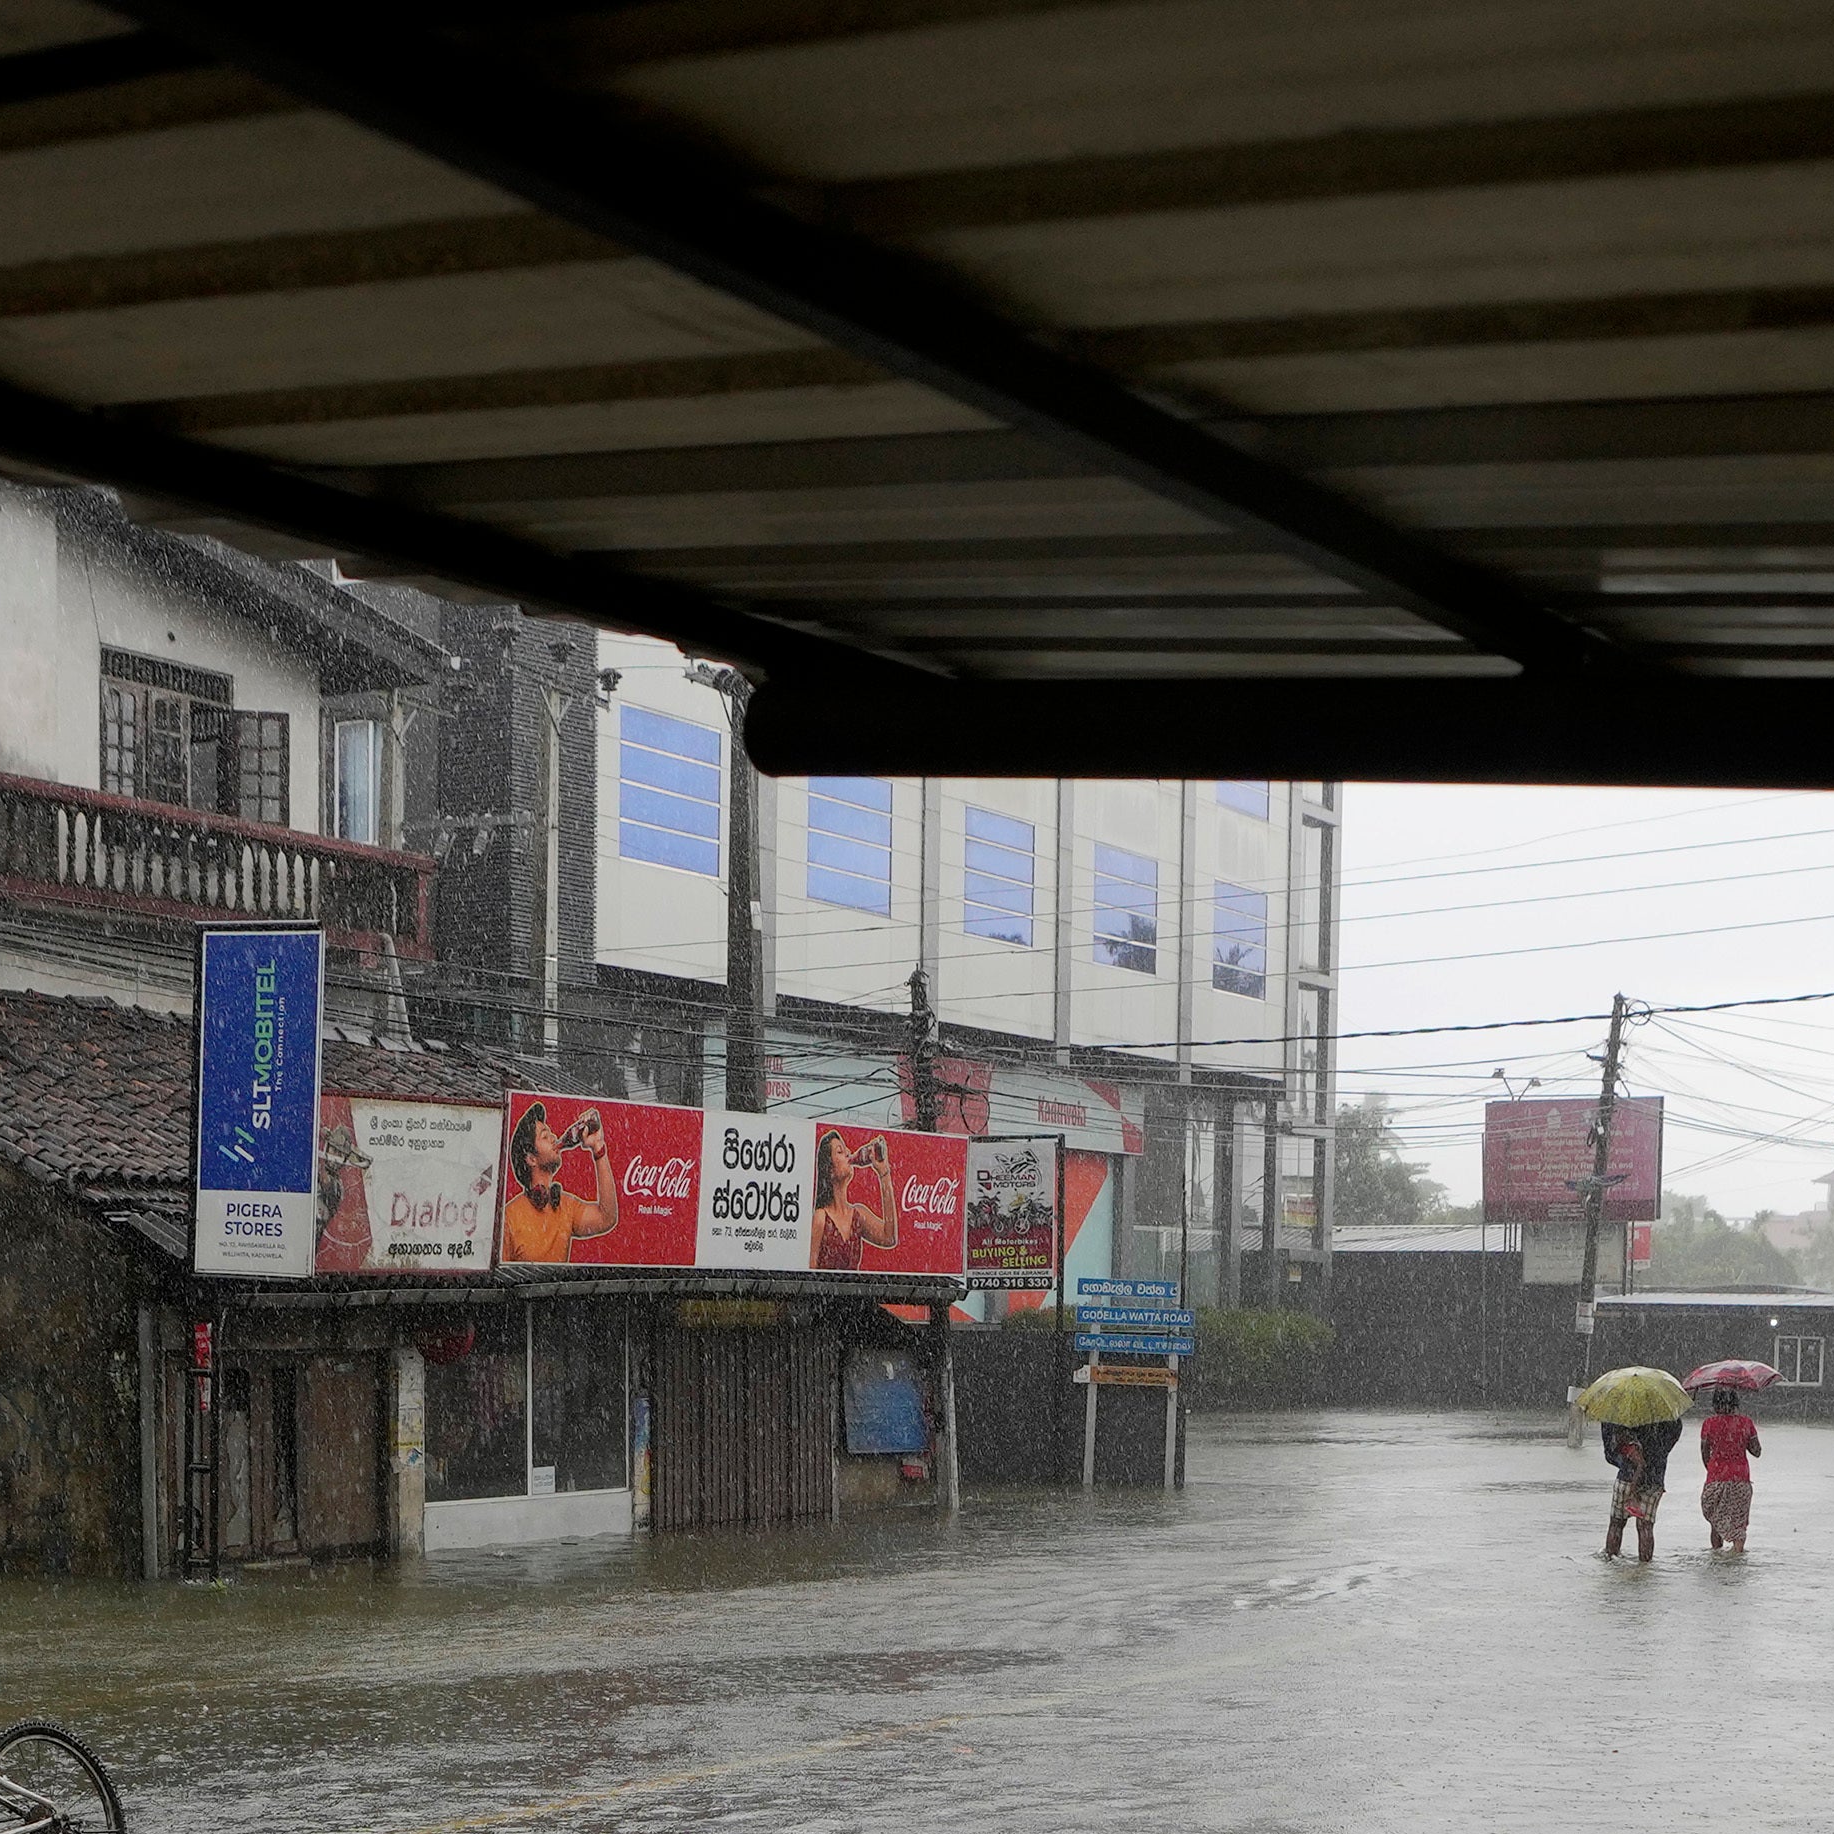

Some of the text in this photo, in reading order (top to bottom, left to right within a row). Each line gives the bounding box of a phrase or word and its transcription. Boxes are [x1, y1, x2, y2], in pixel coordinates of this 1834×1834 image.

[252, 959, 277, 1130] SLTMOBITEL
[275, 996, 285, 1092] The Connection
[723, 1127, 795, 1173] පිගේරා
[623, 1155, 696, 1199] Coca-Cola
[992, 1180, 1036, 1189] MOTORS
[901, 1174, 960, 1215] Coca-Cola
[226, 1202, 283, 1219] PIGERA
[390, 1192, 479, 1237] Dialog
[638, 1205, 673, 1217] Real Magic
[225, 1221, 283, 1237] STORES
[914, 1220, 943, 1231] Real Magic
[388, 1240, 442, 1256] අනාගතය
[981, 1238, 1038, 1246] All Motorbikes
[972, 1246, 1028, 1258] BUYING &
[1002, 1255, 1048, 1268] SELLING
[971, 1278, 1049, 1288] 0740 316 330
[1082, 1310, 1192, 1323] GODELLA WATTA ROAD
